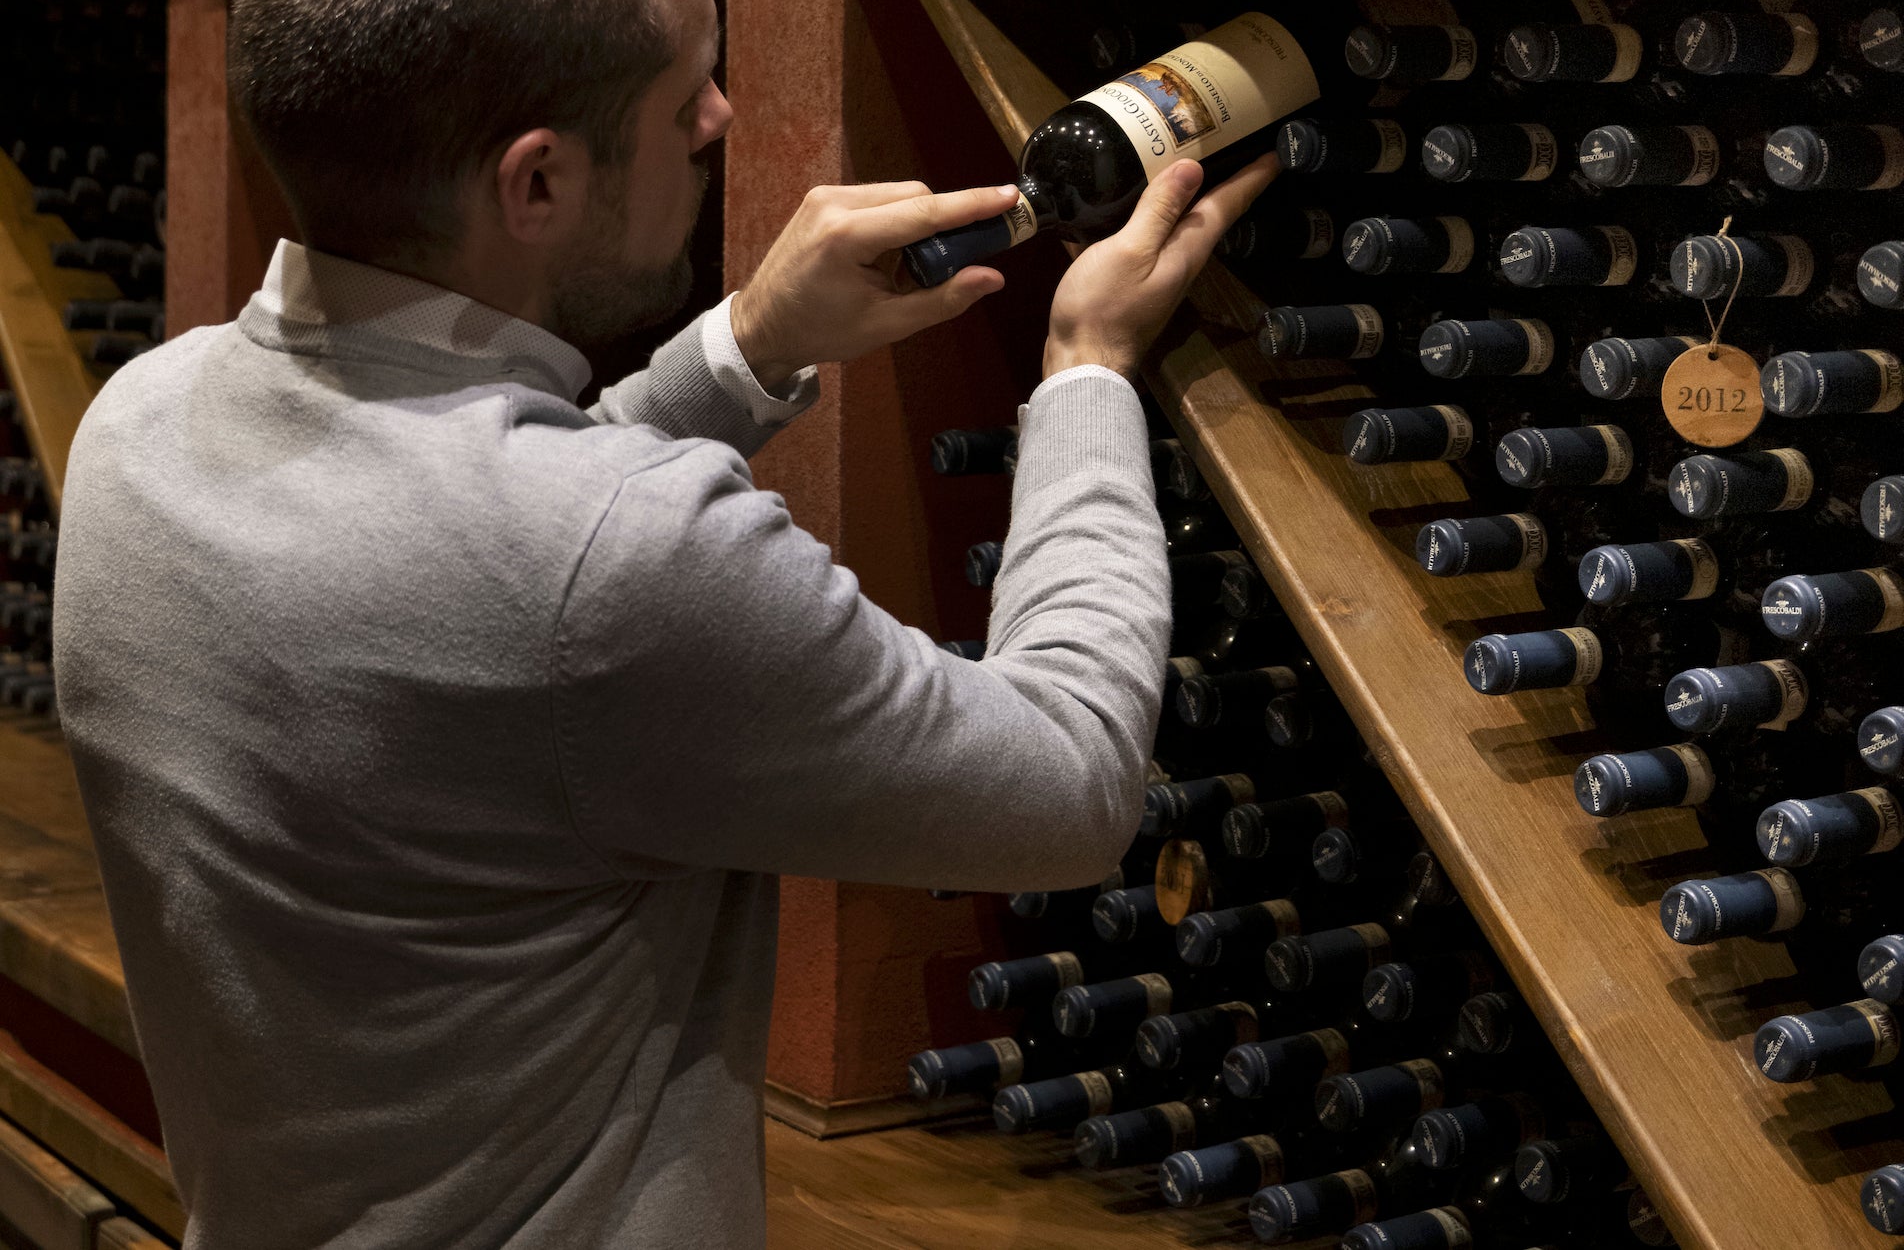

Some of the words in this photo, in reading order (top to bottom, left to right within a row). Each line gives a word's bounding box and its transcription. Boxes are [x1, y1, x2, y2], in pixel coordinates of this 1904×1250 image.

[1683, 21, 1706, 67] FRESCOBALDI
[1286, 123, 1296, 167] FRESCOBALDI
[1580, 151, 1615, 163] FRESCOBALDI
[1766, 143, 1804, 171] FRESCOBALDI
[1860, 260, 1899, 293] FRESCOBALDI
[1420, 343, 1452, 357] FRESCOBALDI
[1587, 345, 1609, 391] FRESCOBALDI
[1678, 386, 1746, 413] 2012
[1350, 420, 1369, 456] FRESCOBALDI
[1499, 441, 1528, 478] FRESCOBALDI
[1680, 462, 1695, 513] FRESCOBALDI
[1878, 484, 1886, 539] FRESCOBALDI
[1427, 525, 1438, 571] FRESCOBALDI
[1588, 555, 1605, 599] FRESCOBALDI
[1762, 605, 1802, 615] FRESCOBALDI
[1474, 642, 1488, 690] FRESCOBALDI
[1667, 694, 1703, 713] FRESCOBALDI
[1860, 734, 1898, 757] FRESCOBALDI
[1583, 762, 1600, 812] FRESCOBALDI
[1768, 811, 1785, 860] FRESCOBALDI
[1673, 892, 1686, 940] FRESCOBALDI
[1862, 958, 1898, 989] FRESCOBALDI
[1761, 1032, 1787, 1074] FRESCOBALDI
[1871, 1177, 1893, 1233] FRESCOBALDI
